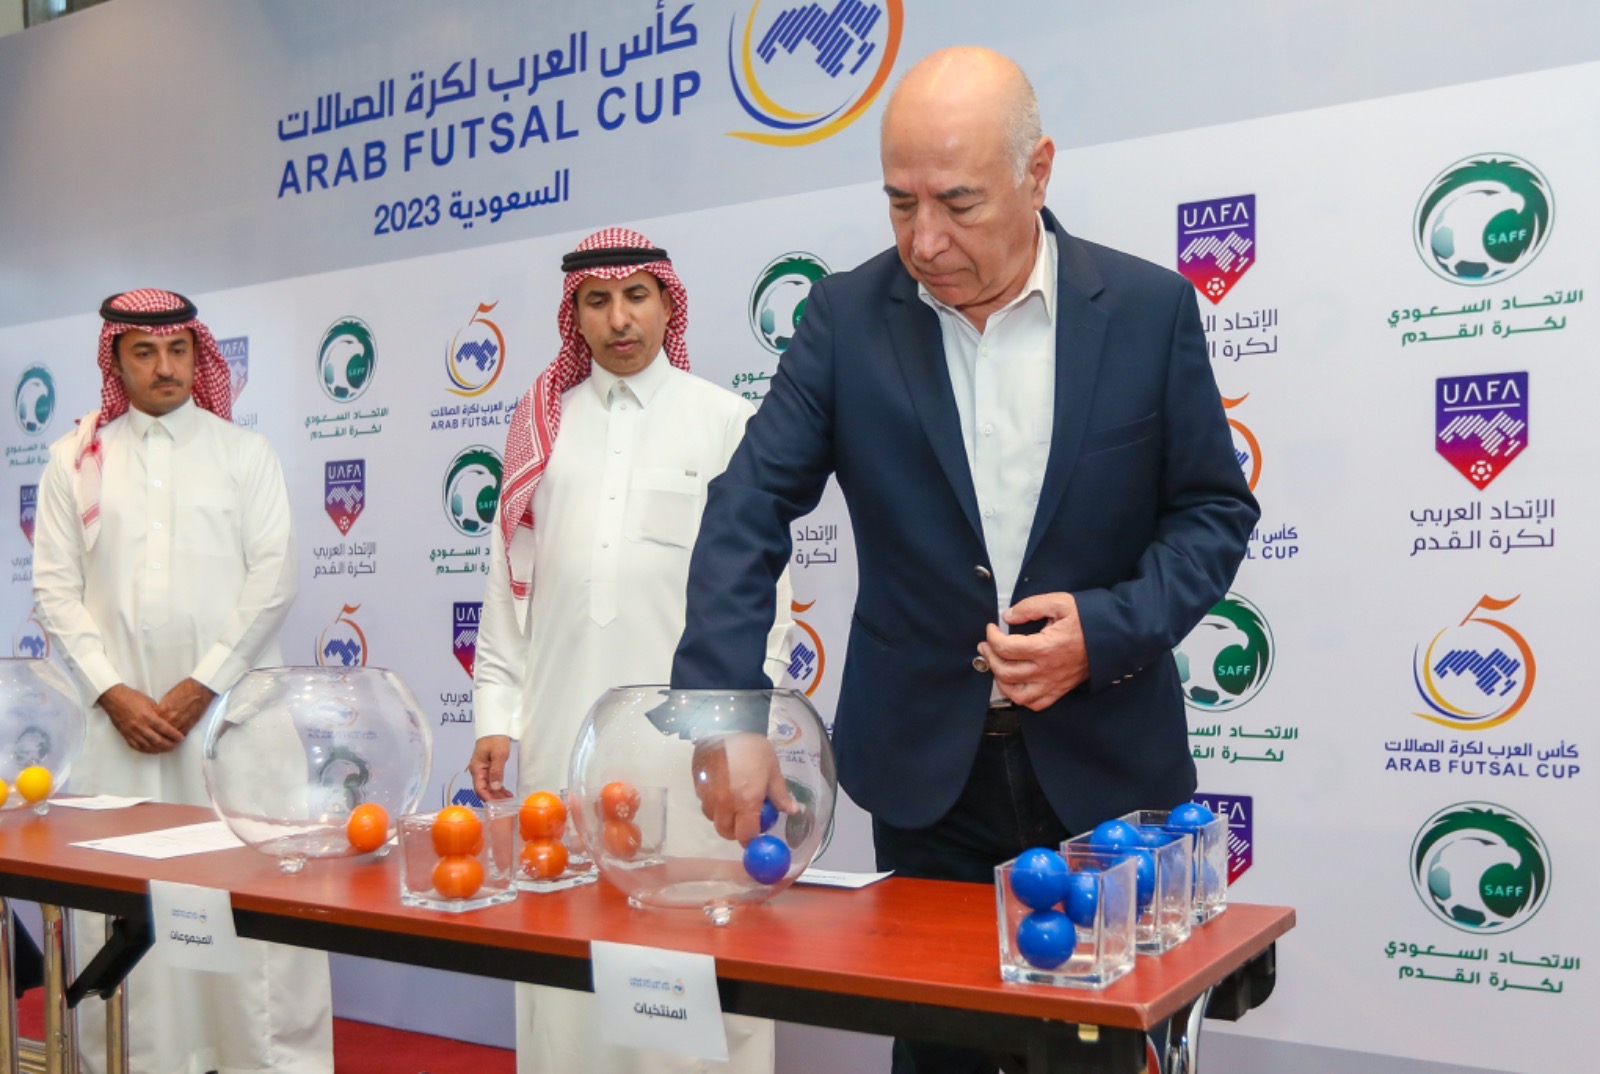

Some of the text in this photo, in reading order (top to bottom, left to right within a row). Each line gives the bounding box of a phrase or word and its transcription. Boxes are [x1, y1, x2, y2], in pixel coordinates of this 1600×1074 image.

[278, 0, 698, 142] كأس العرب لكرة الصالات
[277, 70, 701, 199] ARAB FUTSAL CUP
[374, 168, 569, 235] السعودية 2023
[1183, 201, 1249, 228] UAFA
[1487, 229, 1527, 246] SAFF
[1387, 289, 1584, 328] الاتحاد السعودي
[1223, 308, 1278, 333] الإتحاد
[1401, 316, 1567, 347] لكرة القدم
[1222, 335, 1278, 362] لكرة
[1443, 379, 1521, 404] UAFA
[431, 419, 459, 430] ARAB
[461, 415, 501, 428] FUTSAL
[1410, 498, 1555, 527] الإتحاد العربي
[1262, 523, 1298, 544] كأس
[1410, 527, 1555, 557] لكرة القدم
[313, 543, 345, 560] العربي
[430, 546, 480, 561] السعودي
[795, 547, 837, 568] لكرة
[1262, 546, 1299, 560] CUP
[313, 560, 376, 579] لكرة القدم
[436, 562, 477, 575] القدم
[456, 607, 482, 620] UAF
[1218, 665, 1251, 676] SAFF
[440, 689, 473, 707] لعربي
[440, 709, 473, 726] لقدم
[1229, 724, 1298, 740] الاتحاد
[1192, 744, 1284, 764] لكرة الق
[1384, 739, 1579, 761] كأس العرب لكرة الصالات
[1385, 757, 1580, 779] ARAB FUTSAL CUP
[1190, 799, 1246, 821] AFA
[1485, 884, 1523, 897] SAFF
[1384, 940, 1581, 970] الاتحاد السعودي
[1399, 964, 1564, 993] لكرة القدم
[634, 1002, 688, 1020] المنتخبات
